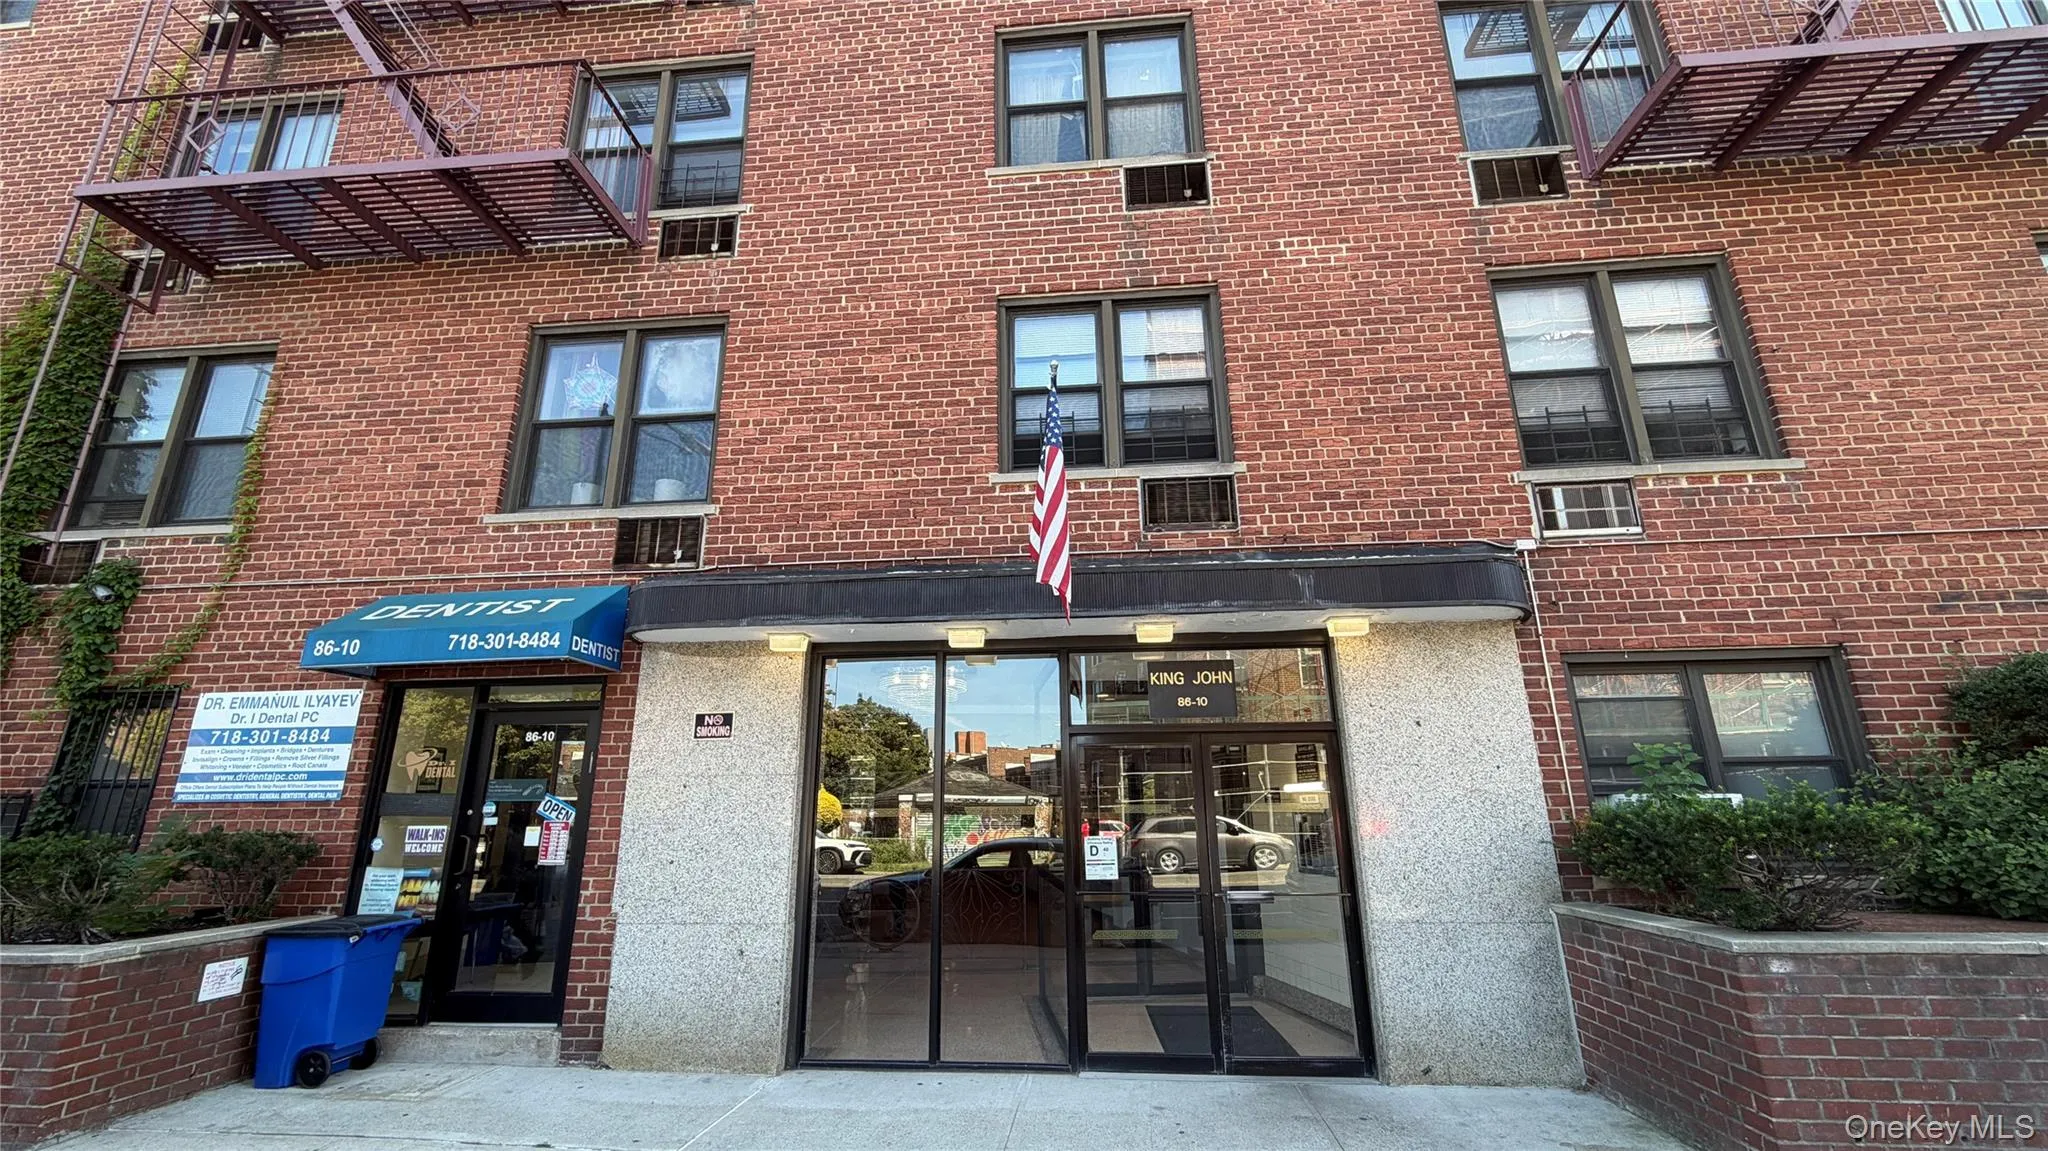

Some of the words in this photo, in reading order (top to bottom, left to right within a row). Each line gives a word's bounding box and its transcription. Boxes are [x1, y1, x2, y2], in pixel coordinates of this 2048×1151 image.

[360, 597, 576, 621] DENTIST
[313, 638, 361, 657] 86-10
[448, 632, 561, 651] 718-301-8484
[571, 635, 621, 663] DENTIST
[1150, 671, 1184, 686] KING
[1192, 670, 1233, 685] JOHN
[203, 697, 225, 710] DR.
[229, 695, 300, 710] EMMANUIL
[303, 693, 359, 708] ILYAYEV
[1177, 697, 1208, 707] 86-10
[230, 713, 247, 724] Dr.
[251, 713, 255, 724] I
[258, 711, 297, 724] Dental
[300, 711, 320, 723] PC
[704, 714, 724, 726] NO
[209, 728, 331, 745] 718-301-8484
[525, 731, 555, 742] 86-10
[696, 725, 731, 737] SMOKING
[213, 772, 308, 782] www.dridentalpc.com
[425, 766, 456, 778] DENTAL
[542, 799, 573, 822] OPEN
[407, 828, 446, 841] WALK-INS
[404, 843, 444, 853] WELCOME
[1090, 845, 1099, 857] D
